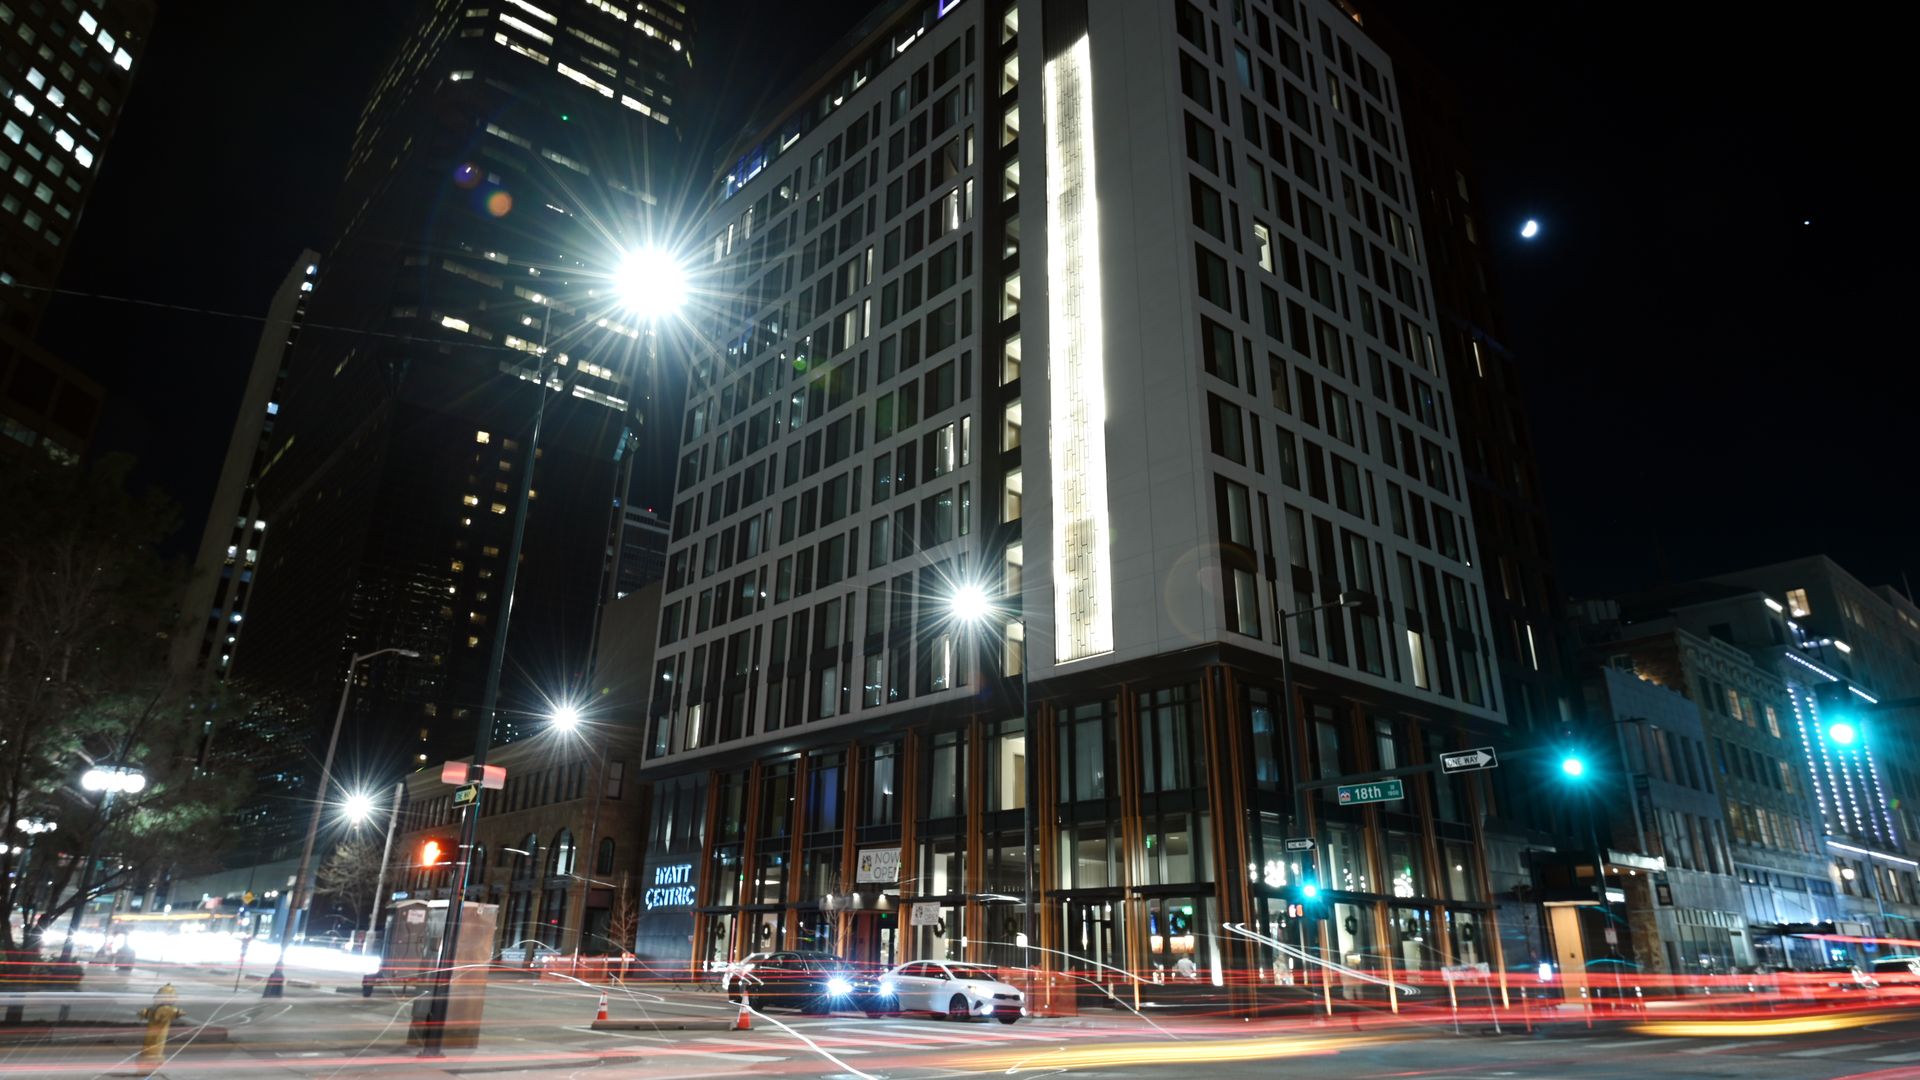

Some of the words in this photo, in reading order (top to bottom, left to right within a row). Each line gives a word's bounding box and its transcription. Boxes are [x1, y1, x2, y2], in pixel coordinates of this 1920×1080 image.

[1447, 758, 1462, 767] ONE
[1464, 755, 1478, 765] WAY
[1354, 785, 1382, 800] 18th
[875, 851, 899, 864] NOW
[655, 864, 692, 885] HYATT
[645, 885, 696, 910] CENTRIC
